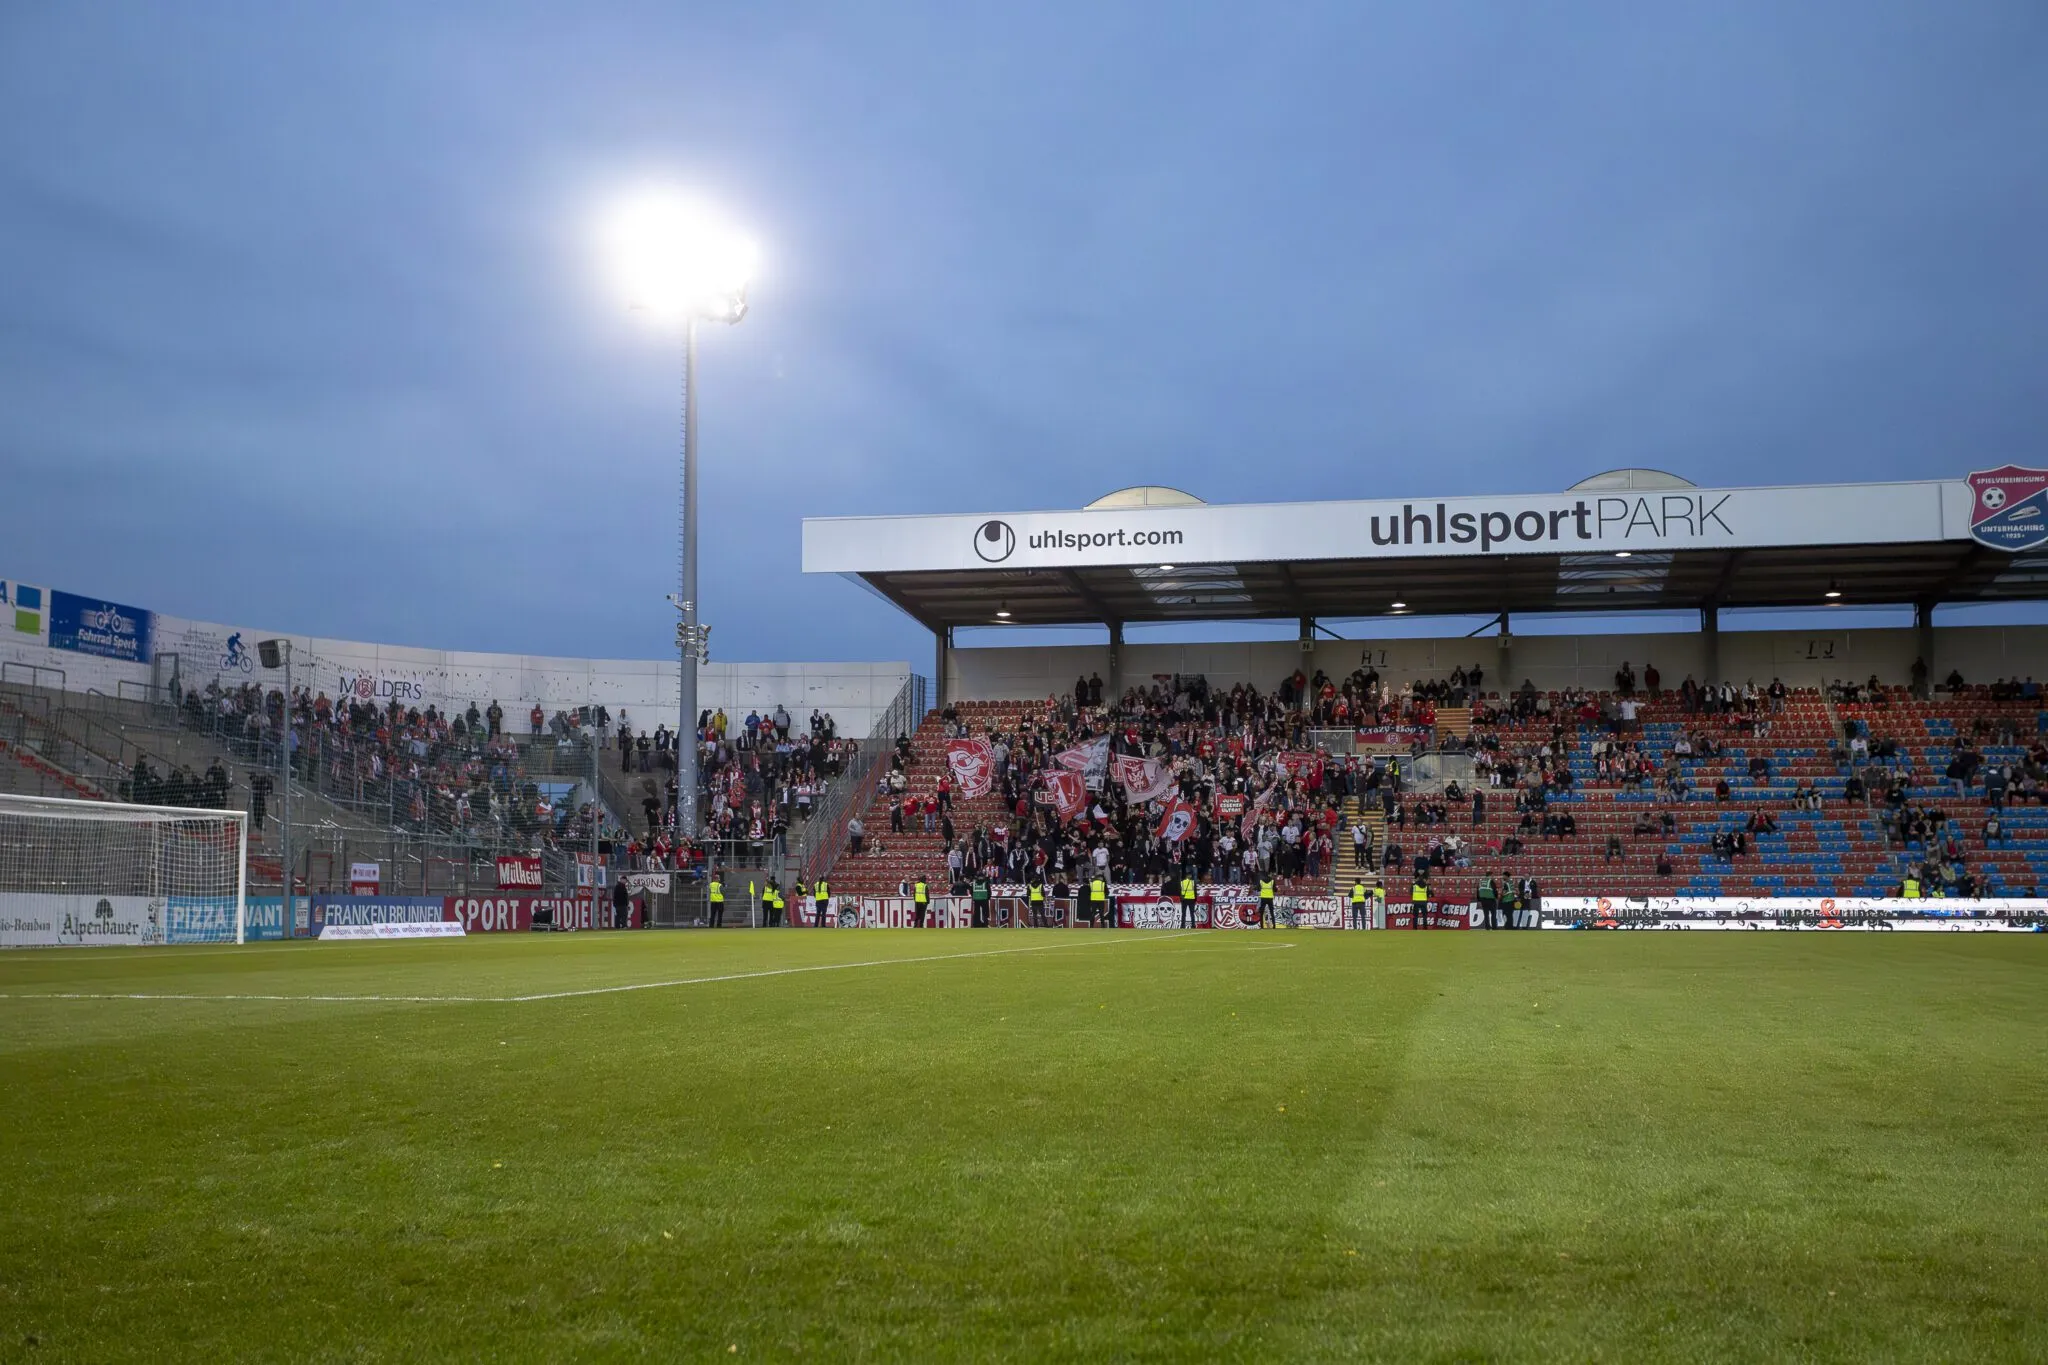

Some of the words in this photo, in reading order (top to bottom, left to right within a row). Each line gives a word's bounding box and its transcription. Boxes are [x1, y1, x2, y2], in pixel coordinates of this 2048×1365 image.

[1976, 475, 2046, 485] SPIELVEREINIGUNG
[1981, 524, 2045, 533] UNTERHACHING
[1029, 529, 1183, 551] uhlsport.com
[1273, 896, 1337, 911] WRECKING
[1442, 902, 1469, 915] CREW
[172, 905, 228, 929] PIZZA
[325, 903, 387, 925] FRANKEN
[389, 904, 442, 924] BRUNNEN
[455, 899, 519, 930] SPORT
[1293, 911, 1331, 925] CREW
[61, 912, 139, 942] Alpenbauer
[1395, 917, 1410, 927] ROT
